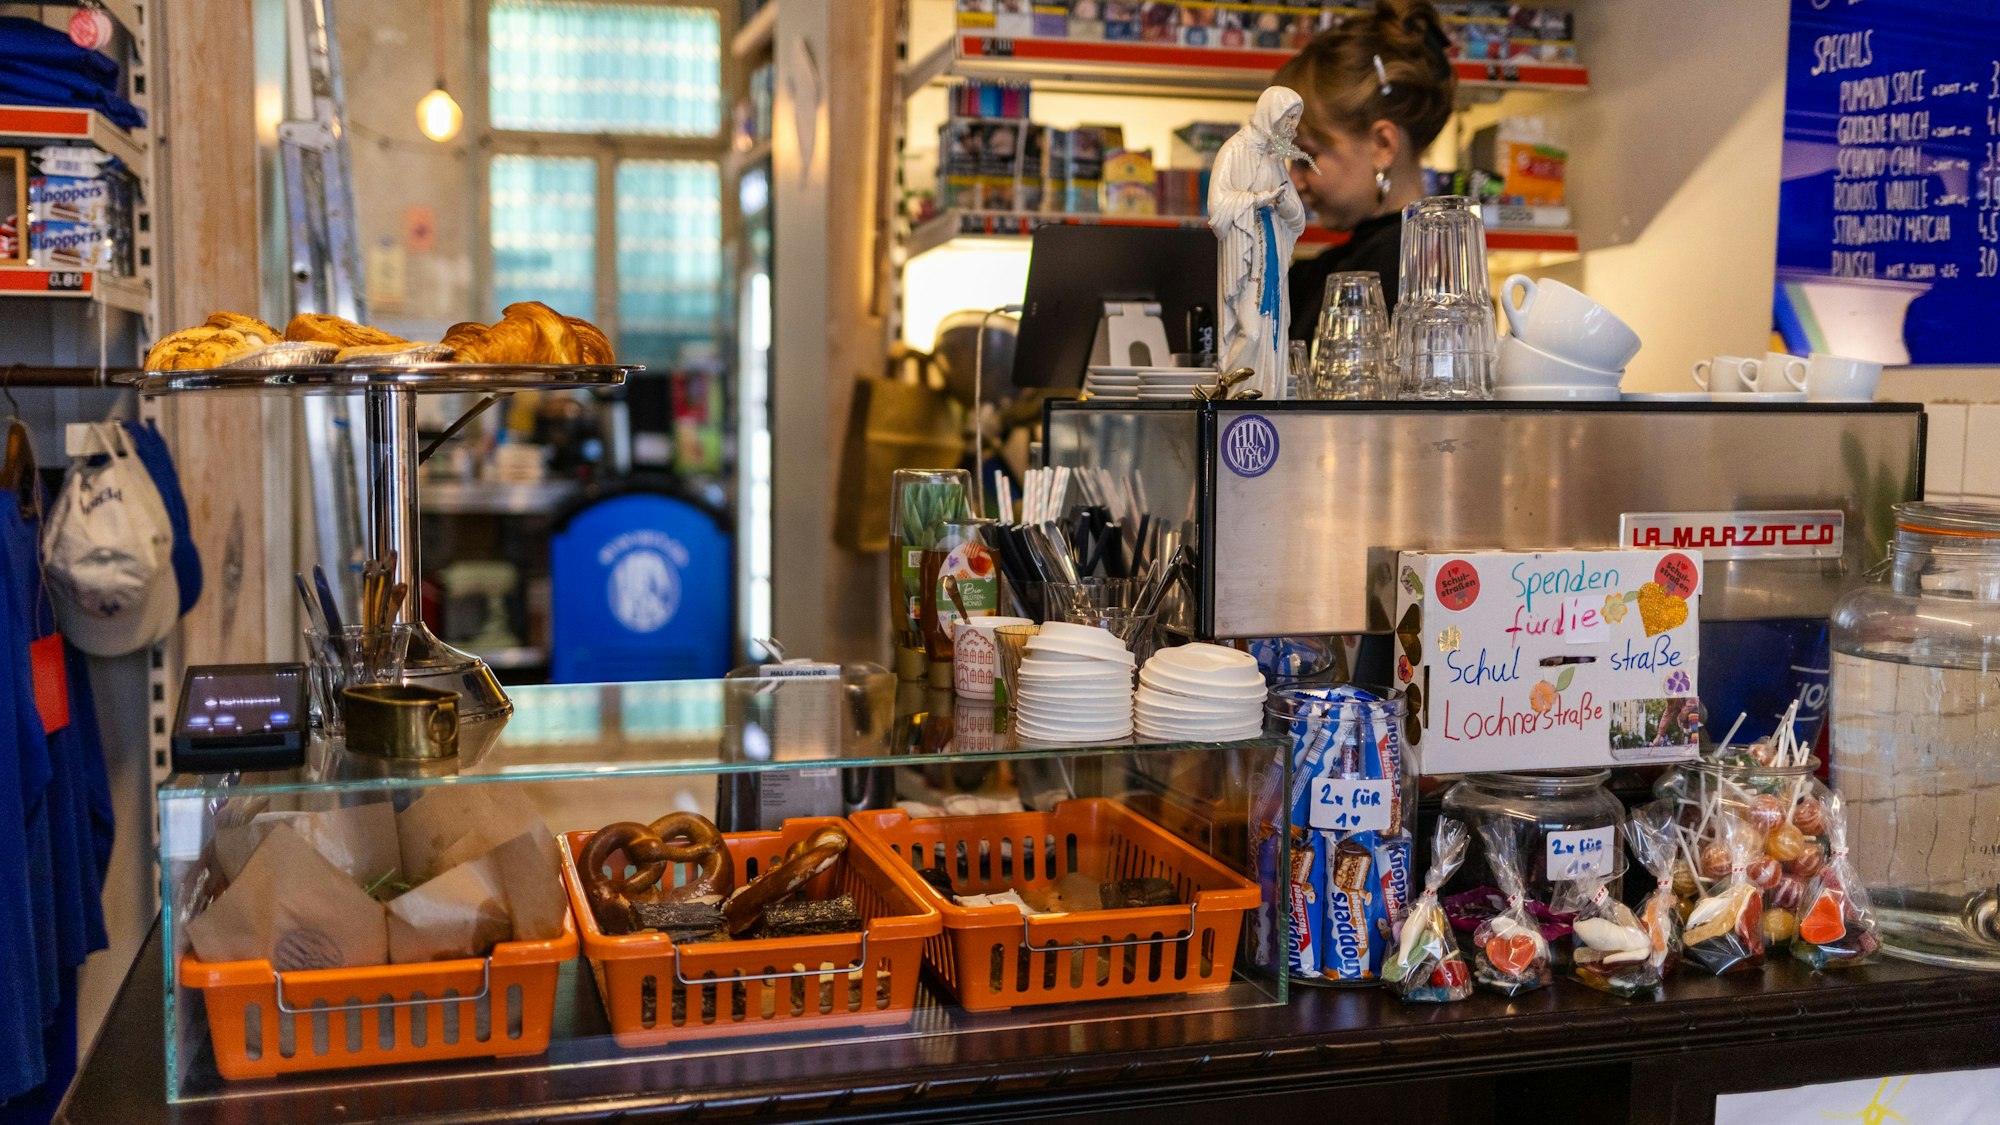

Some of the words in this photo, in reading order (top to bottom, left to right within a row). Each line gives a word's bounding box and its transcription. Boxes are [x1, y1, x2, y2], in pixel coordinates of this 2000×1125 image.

[1811, 29, 1875, 76] SPECIALS
[1891, 69, 1927, 106] SPICE
[1889, 110, 1930, 141] MILCH
[1904, 215, 1951, 243] MATCHA
[1235, 422, 1267, 448] HIN
[1633, 527, 1660, 546] LA
[1441, 579, 1476, 597] straßen
[1512, 560, 1619, 612] Spenden
[1660, 567, 1689, 593] straßen
[1447, 647, 1521, 686] Schul
[1610, 635, 1683, 673] straße
[1445, 692, 1603, 741] Lochnerstraße
[1320, 783, 1344, 806] 2x
[1331, 892, 1361, 979] Knoppers
